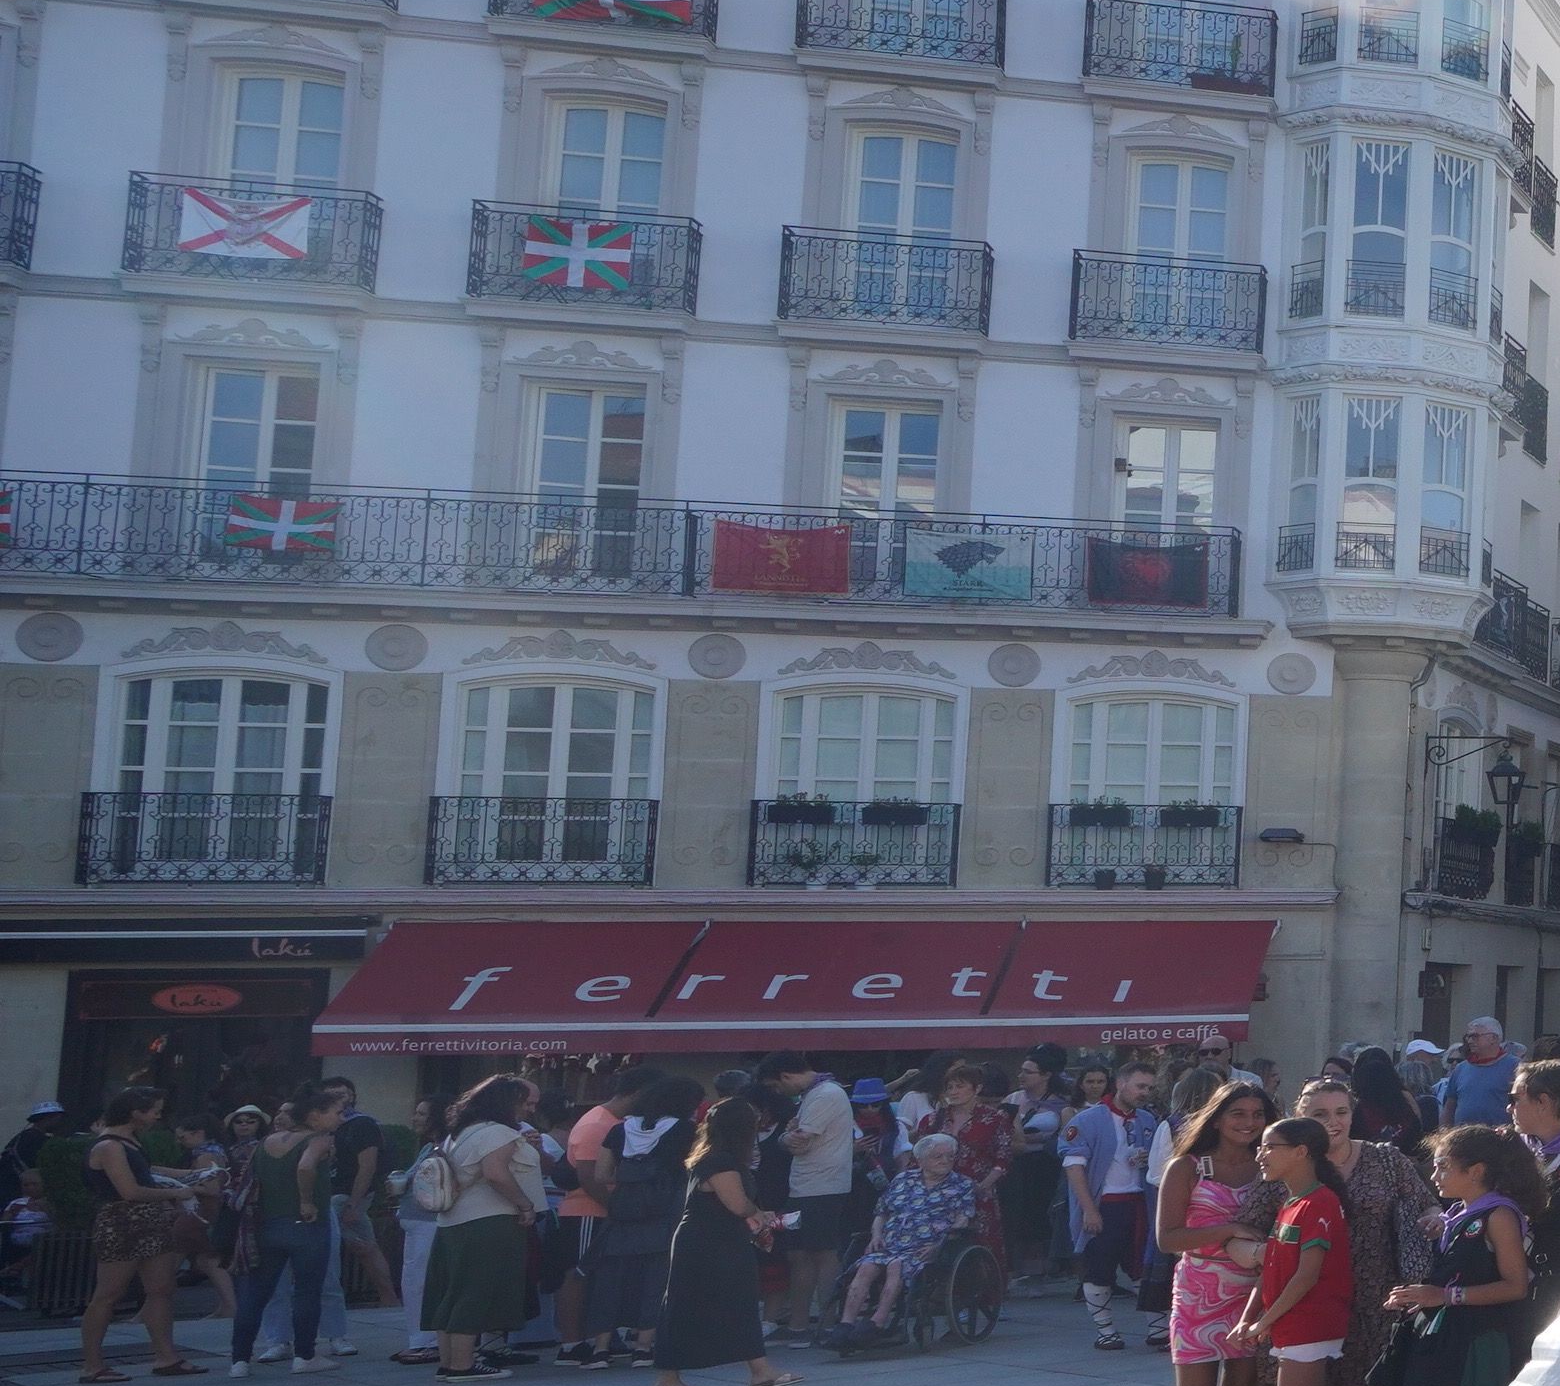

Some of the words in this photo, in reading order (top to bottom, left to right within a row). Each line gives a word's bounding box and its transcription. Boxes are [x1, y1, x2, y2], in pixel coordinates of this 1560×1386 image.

[448, 966, 1132, 1011] ferretti
[350, 1037, 568, 1052] www.ferrettivitoria.com
[1101, 1026, 1158, 1044] gelato
[1162, 1030, 1172, 1039] e
